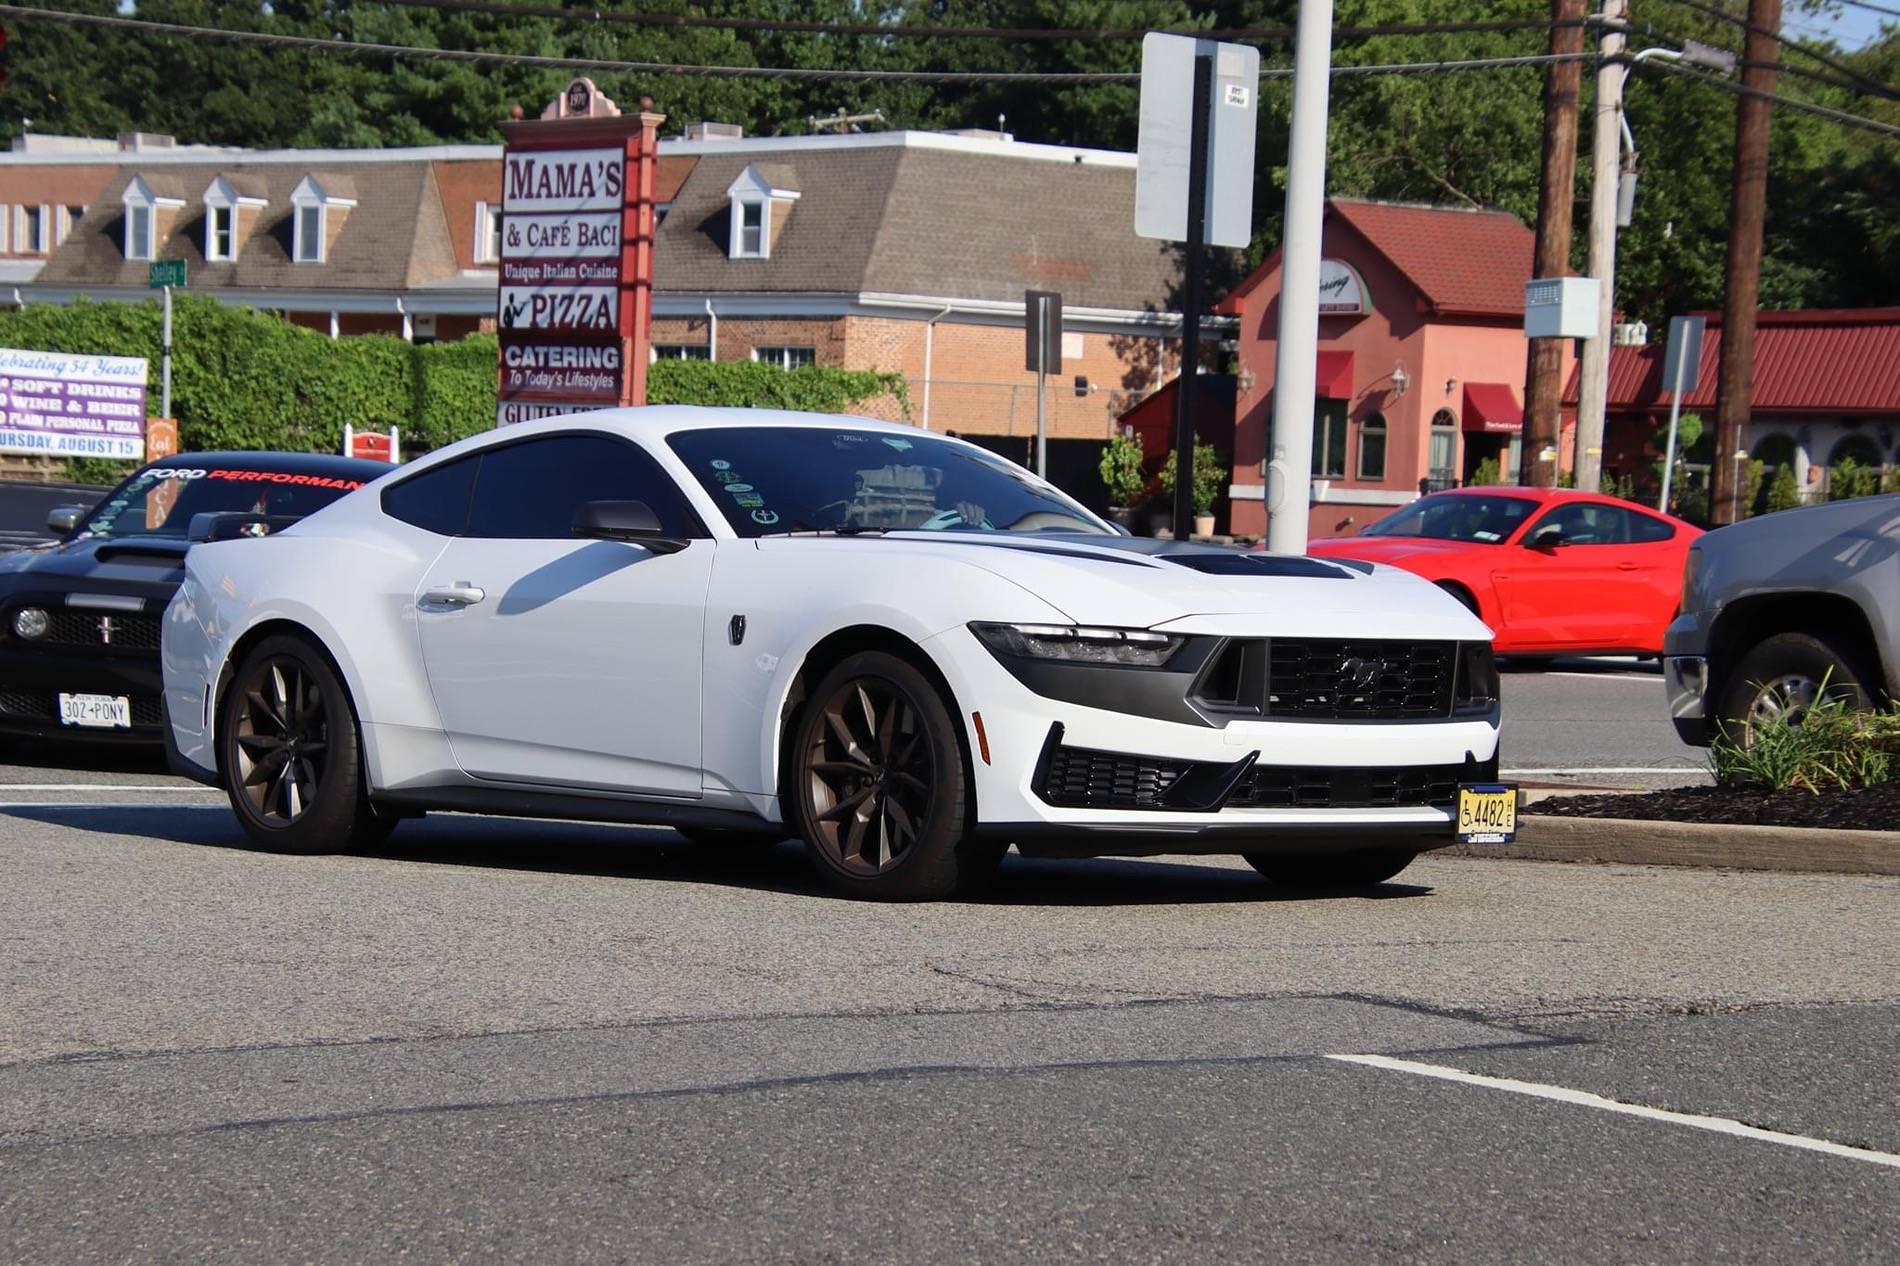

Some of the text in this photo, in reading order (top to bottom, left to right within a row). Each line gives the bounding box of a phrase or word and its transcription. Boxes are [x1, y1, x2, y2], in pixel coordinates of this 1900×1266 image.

[509, 159, 621, 199] MAMA'S
[507, 219, 617, 247] & CAFÉ BACI
[504, 263, 618, 283] Unique Italian Cuisine
[530, 293, 615, 330] PIZZA
[70, 359, 88, 372] 54
[505, 345, 619, 368] CATERING
[11, 379, 63, 394] SOFT
[67, 383, 141, 399] DRINKS
[510, 370, 614, 390] To Today's Lifestyles
[10, 395, 62, 411] WINE
[66, 399, 82, 413] &
[87, 401, 140, 417] BEER
[9, 412, 43, 427] PLAIN
[45, 416, 104, 431] PERSONAL
[106, 419, 139, 433] PIZZA
[57, 436, 113, 454] AUGUST
[118, 440, 134, 455] 15
[141, 469, 206, 479] FORD
[94, 703, 123, 720] PONY
[1475, 800, 1505, 827] 4482
